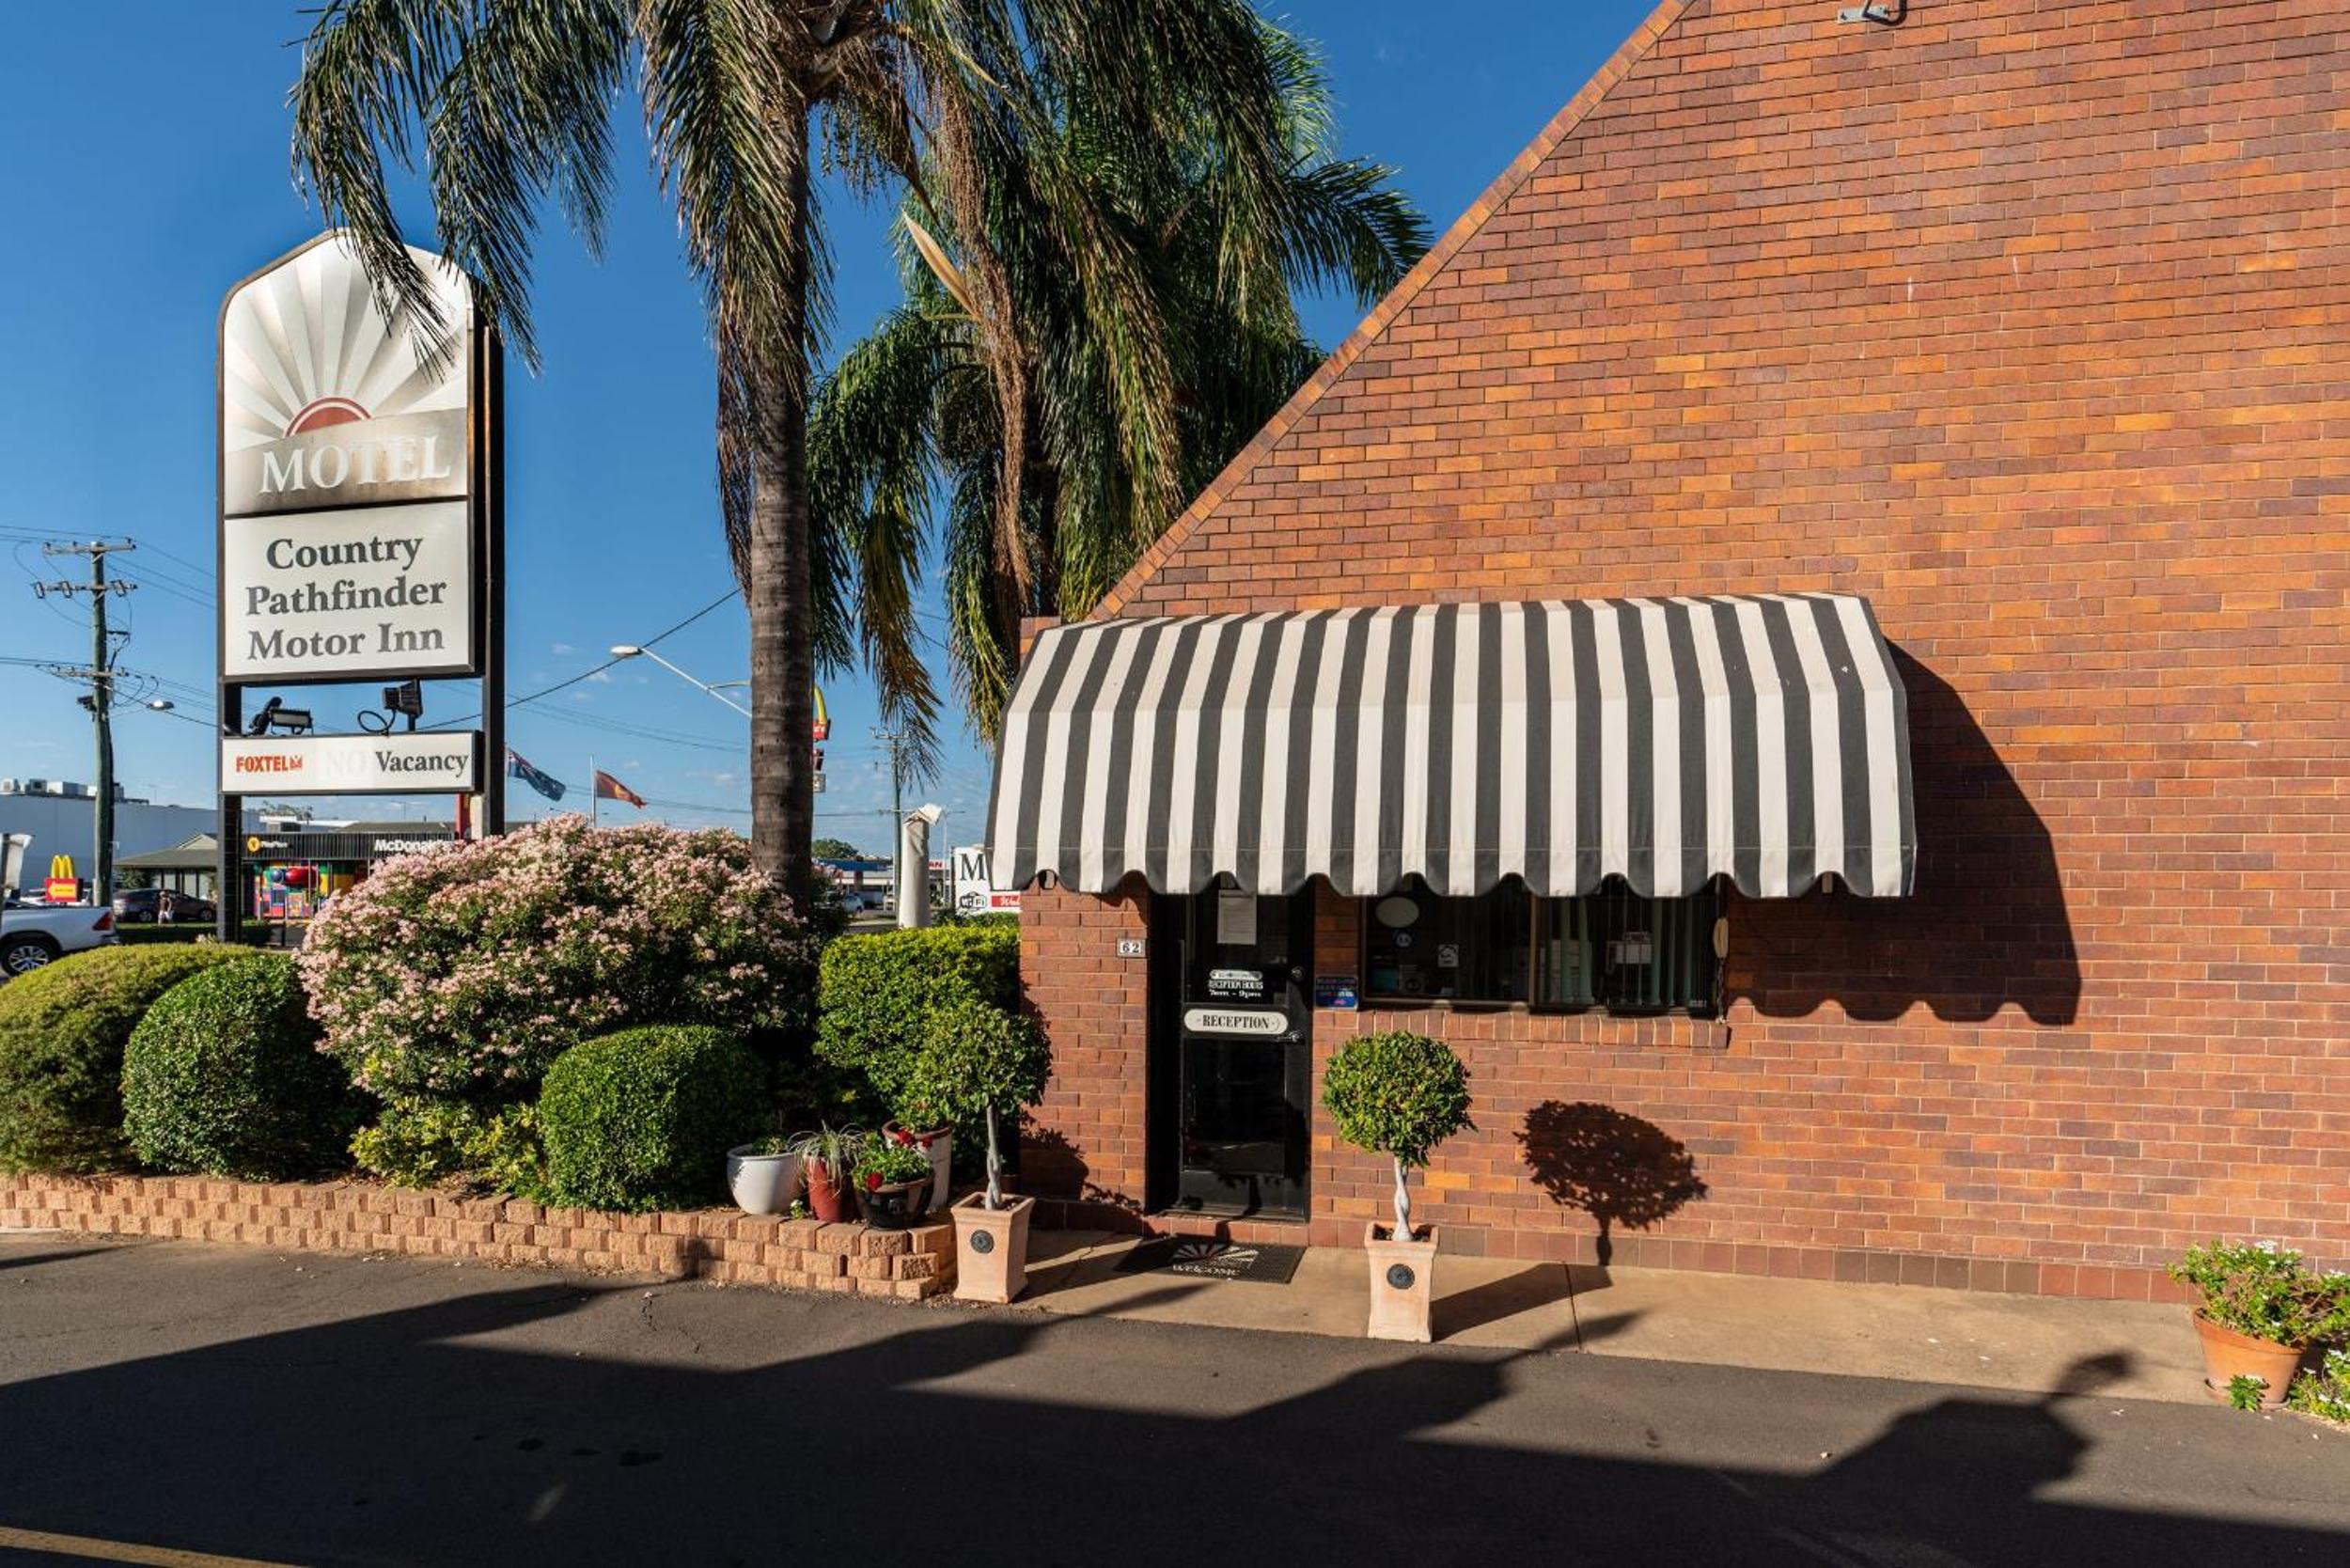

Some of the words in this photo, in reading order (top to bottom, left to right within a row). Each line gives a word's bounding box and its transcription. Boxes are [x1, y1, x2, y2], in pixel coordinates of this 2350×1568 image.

[259, 435, 450, 493] MOTEL
[266, 535, 423, 571] Country
[245, 575, 446, 615] Pathfinder
[247, 629, 366, 660] Motor
[378, 622, 445, 652] Inn
[236, 755, 289, 773] FOXTEL
[375, 751, 469, 777] Vacancy
[1120, 942, 1140, 954] 62
[1202, 1014, 1270, 1029] RECEPTION
